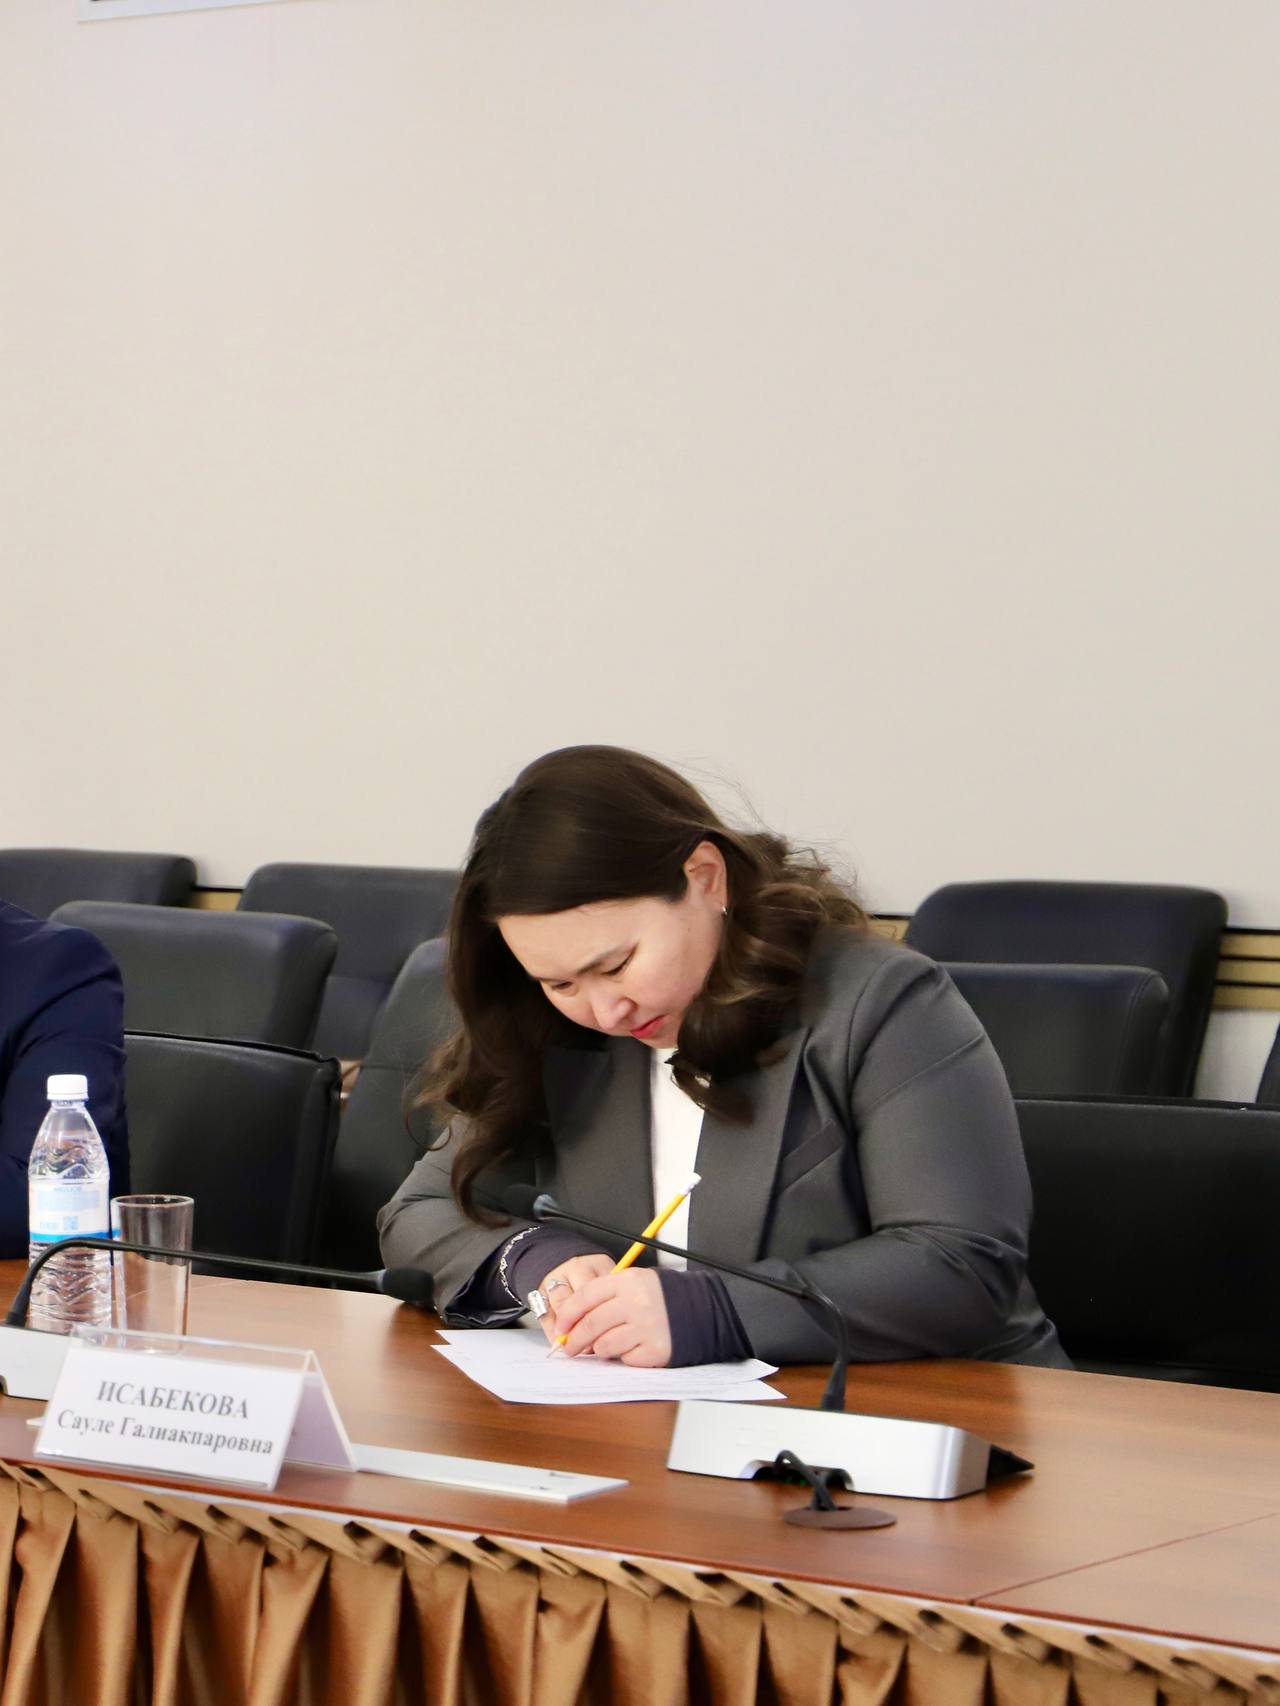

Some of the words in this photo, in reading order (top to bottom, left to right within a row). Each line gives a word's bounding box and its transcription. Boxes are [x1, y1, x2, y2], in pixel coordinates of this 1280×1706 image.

[96, 1381, 249, 1418] ИСАБЕКОВА
[58, 1409, 114, 1435] Сауле
[120, 1417, 273, 1453] Галиакпаровна
